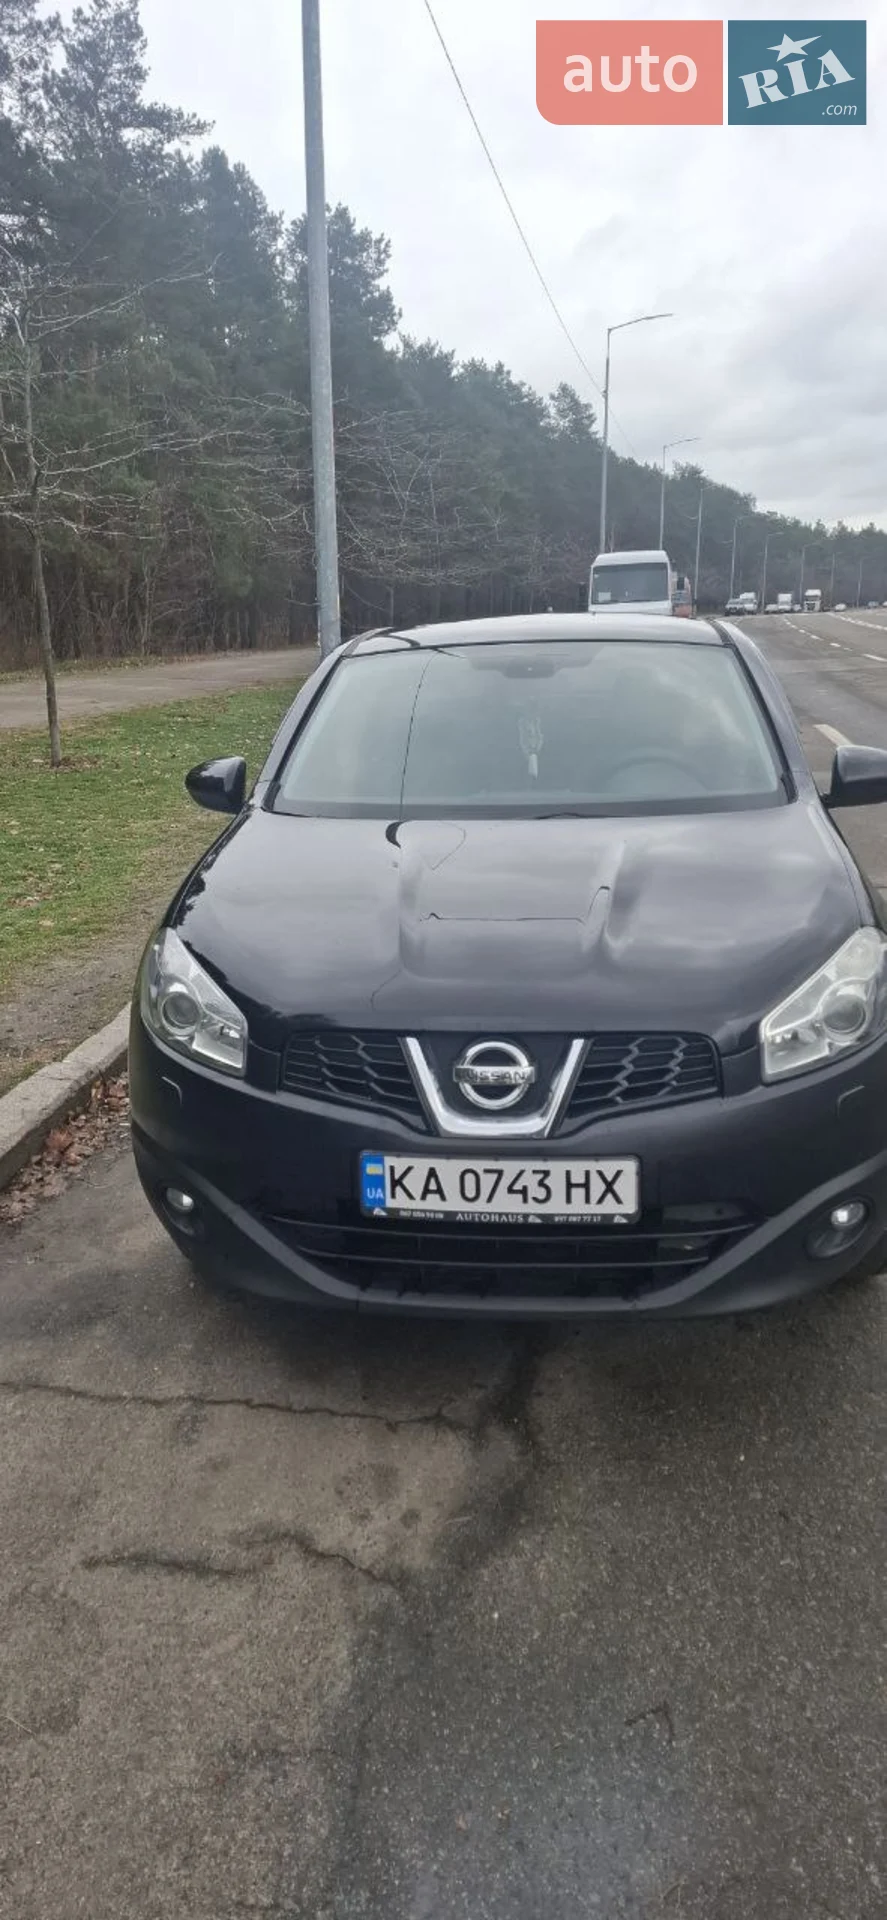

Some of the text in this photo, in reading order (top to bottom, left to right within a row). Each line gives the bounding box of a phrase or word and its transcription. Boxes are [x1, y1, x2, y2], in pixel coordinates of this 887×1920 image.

[389, 1165, 624, 1205] KA 0743 HX
[366, 1187, 385, 1199] UA
[456, 1212, 524, 1223] AUTOHAUS
